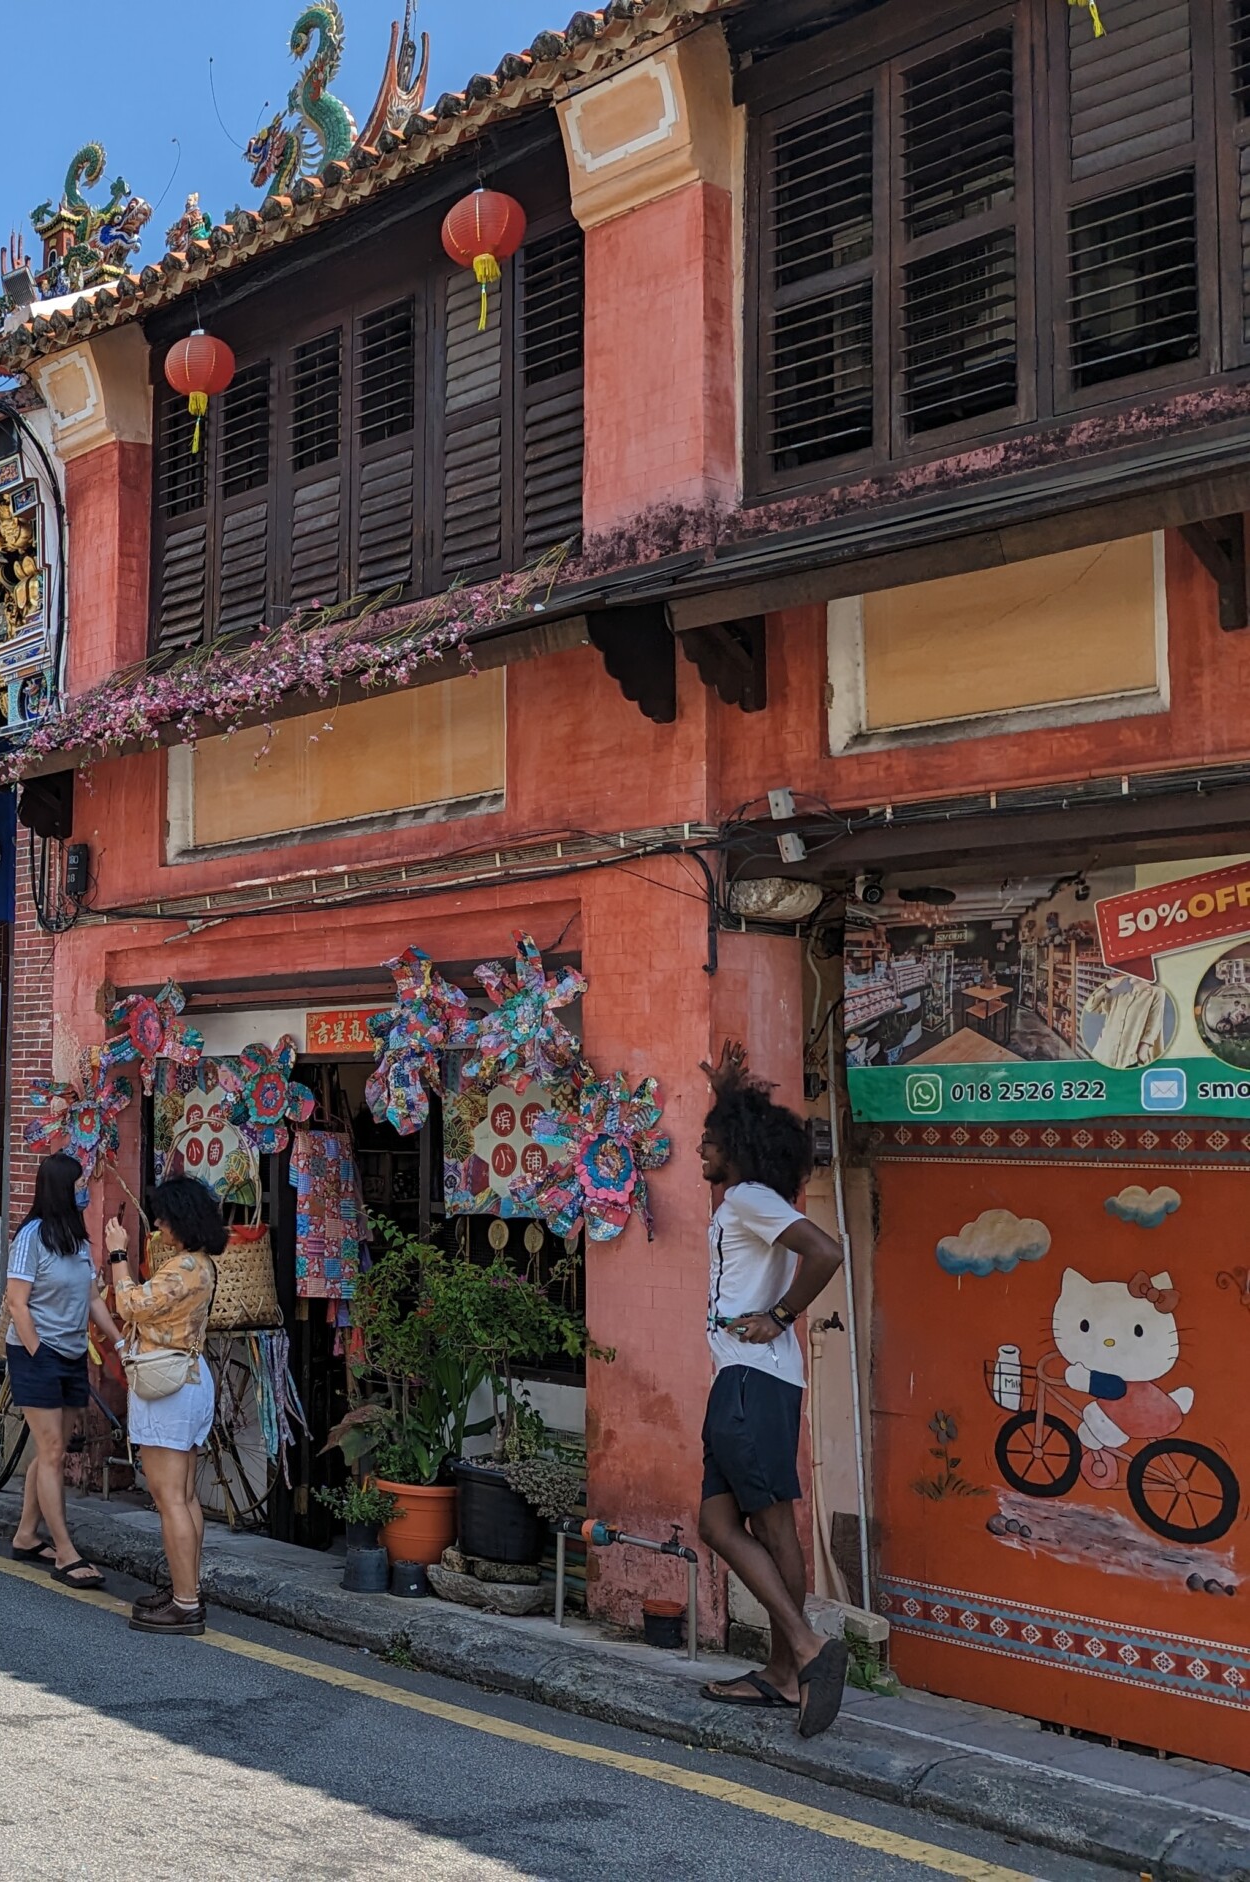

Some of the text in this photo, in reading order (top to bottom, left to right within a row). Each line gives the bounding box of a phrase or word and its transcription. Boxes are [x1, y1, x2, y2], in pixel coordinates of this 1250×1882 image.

[315, 1019, 371, 1045] 吉星高
[951, 1080, 1106, 1101] 018 2526 322
[495, 1149, 542, 1171] 小铺
